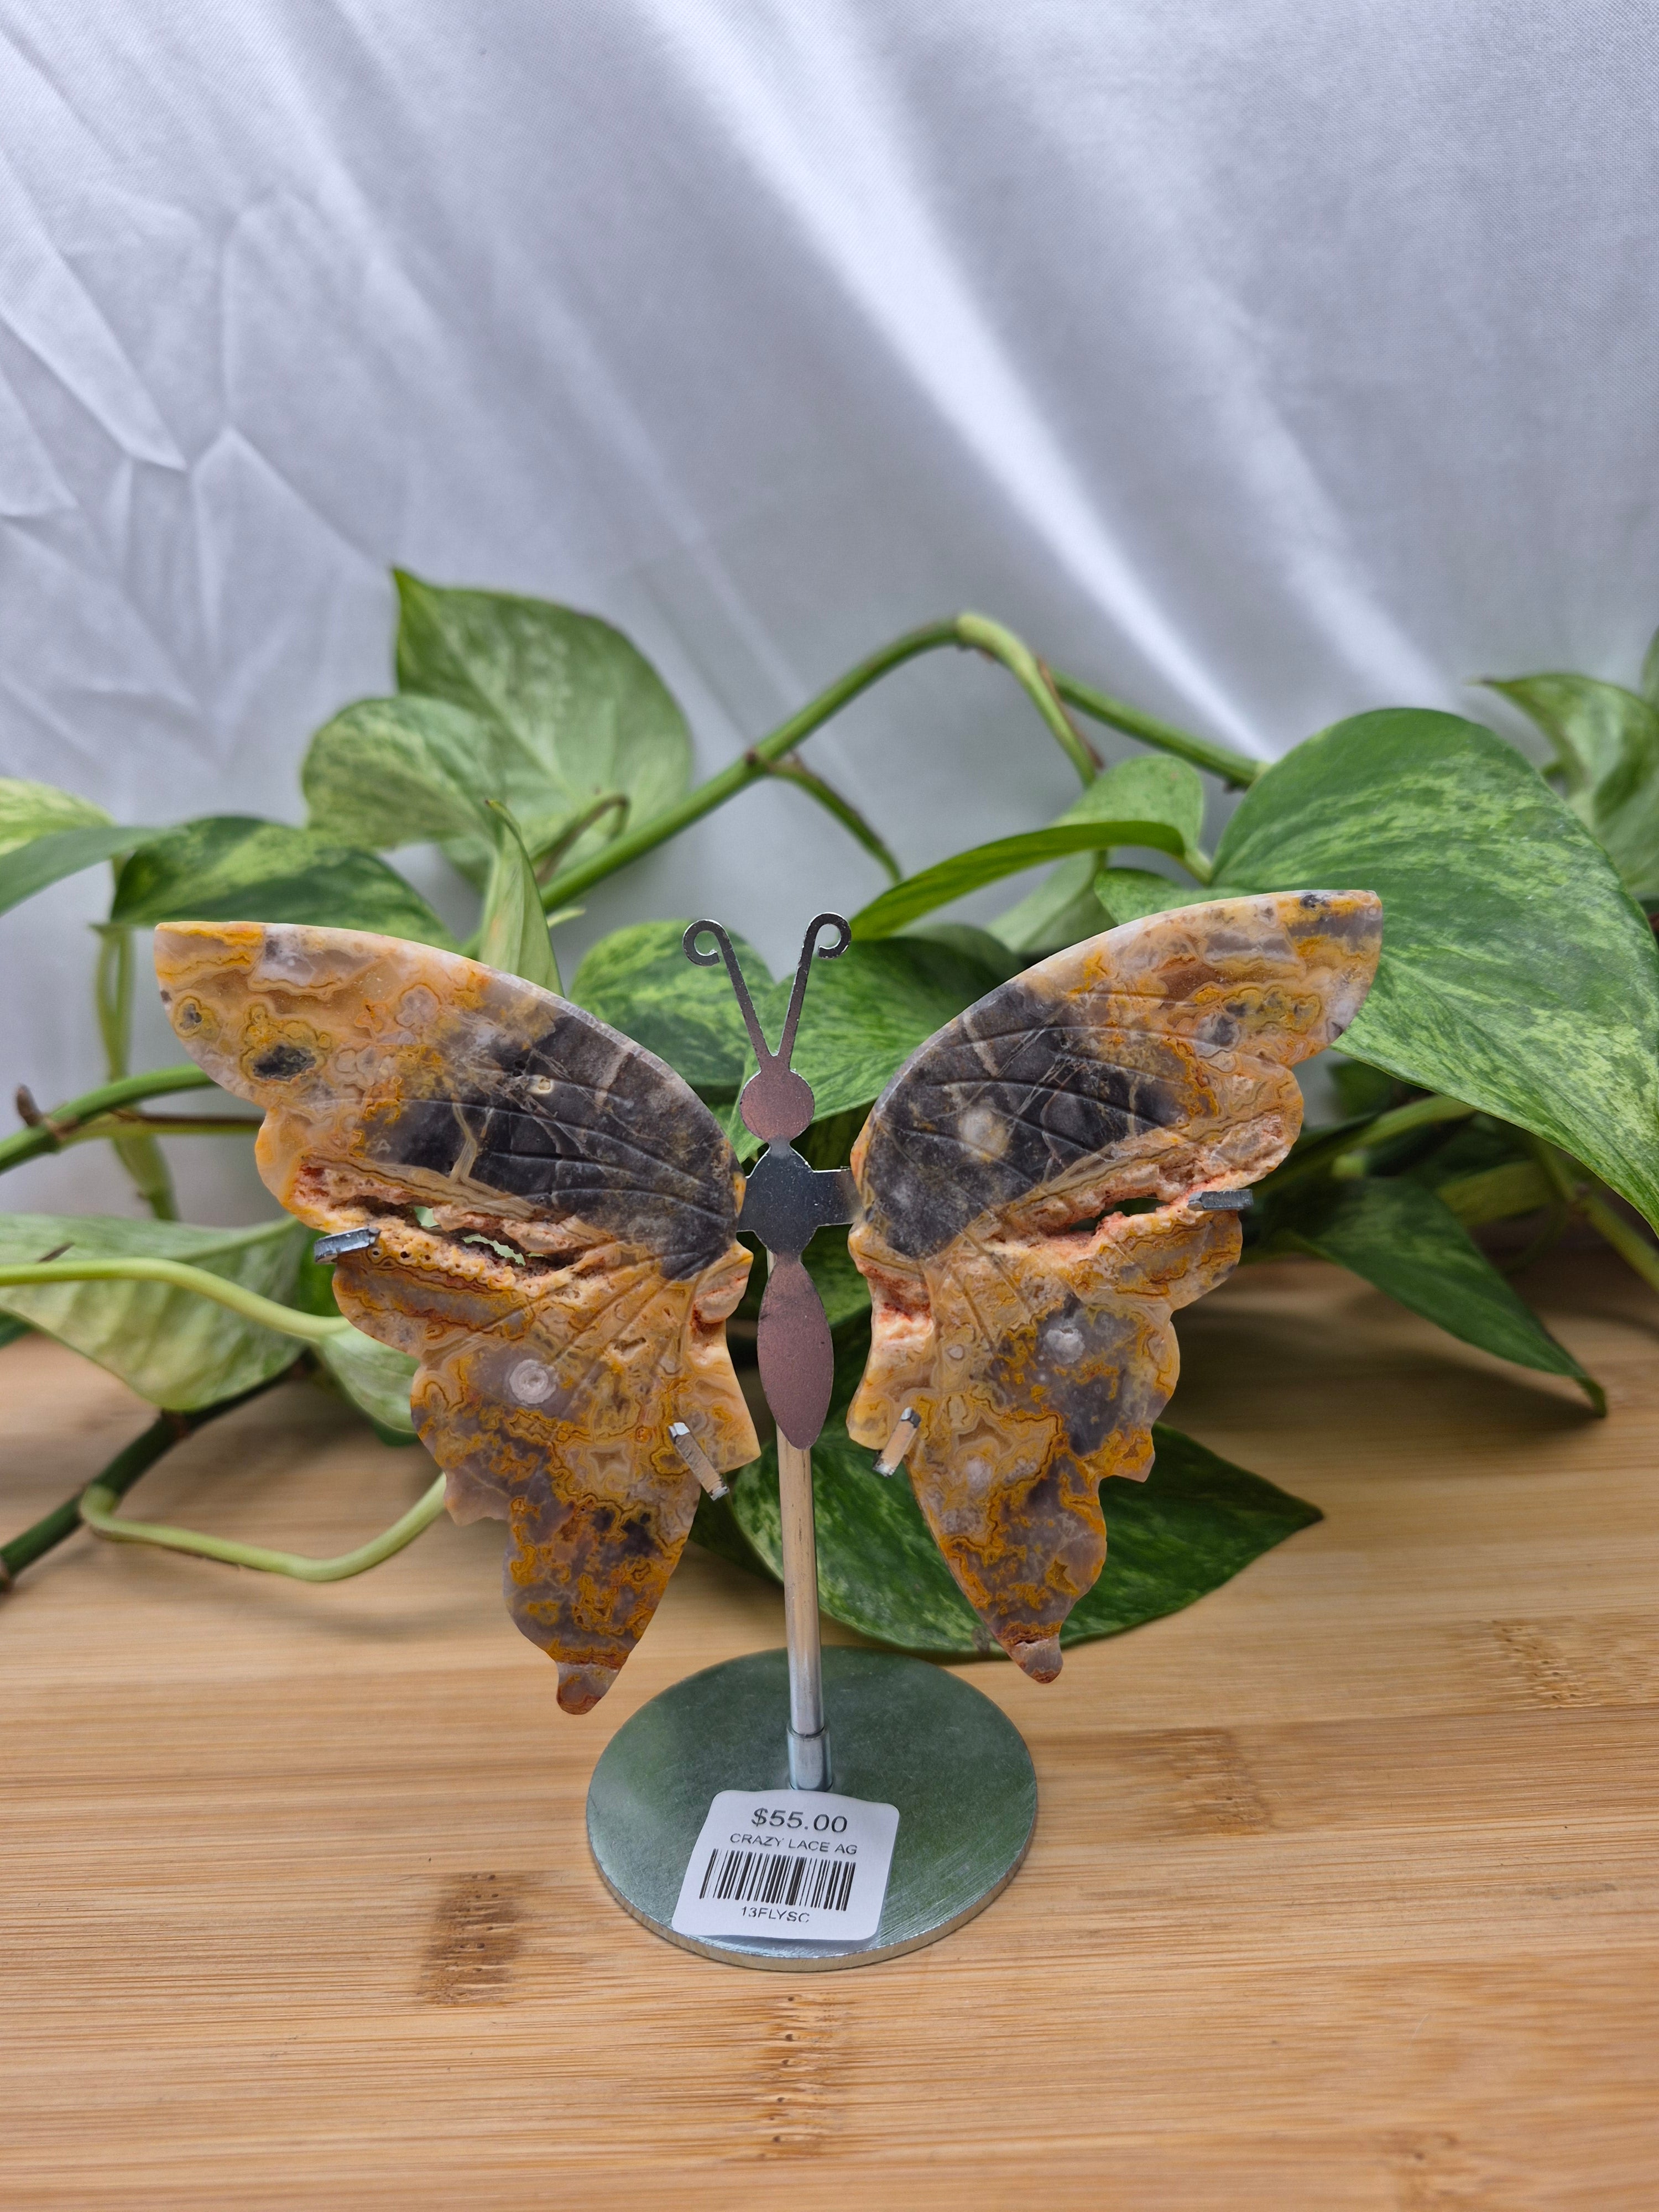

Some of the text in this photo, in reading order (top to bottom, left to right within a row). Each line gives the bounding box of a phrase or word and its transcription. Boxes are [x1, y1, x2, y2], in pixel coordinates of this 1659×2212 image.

[751, 1807, 848, 1833] $55.00
[729, 1833, 858, 1855] CRAZY LACE AG
[741, 1906, 810, 1923] 13FLYSC
